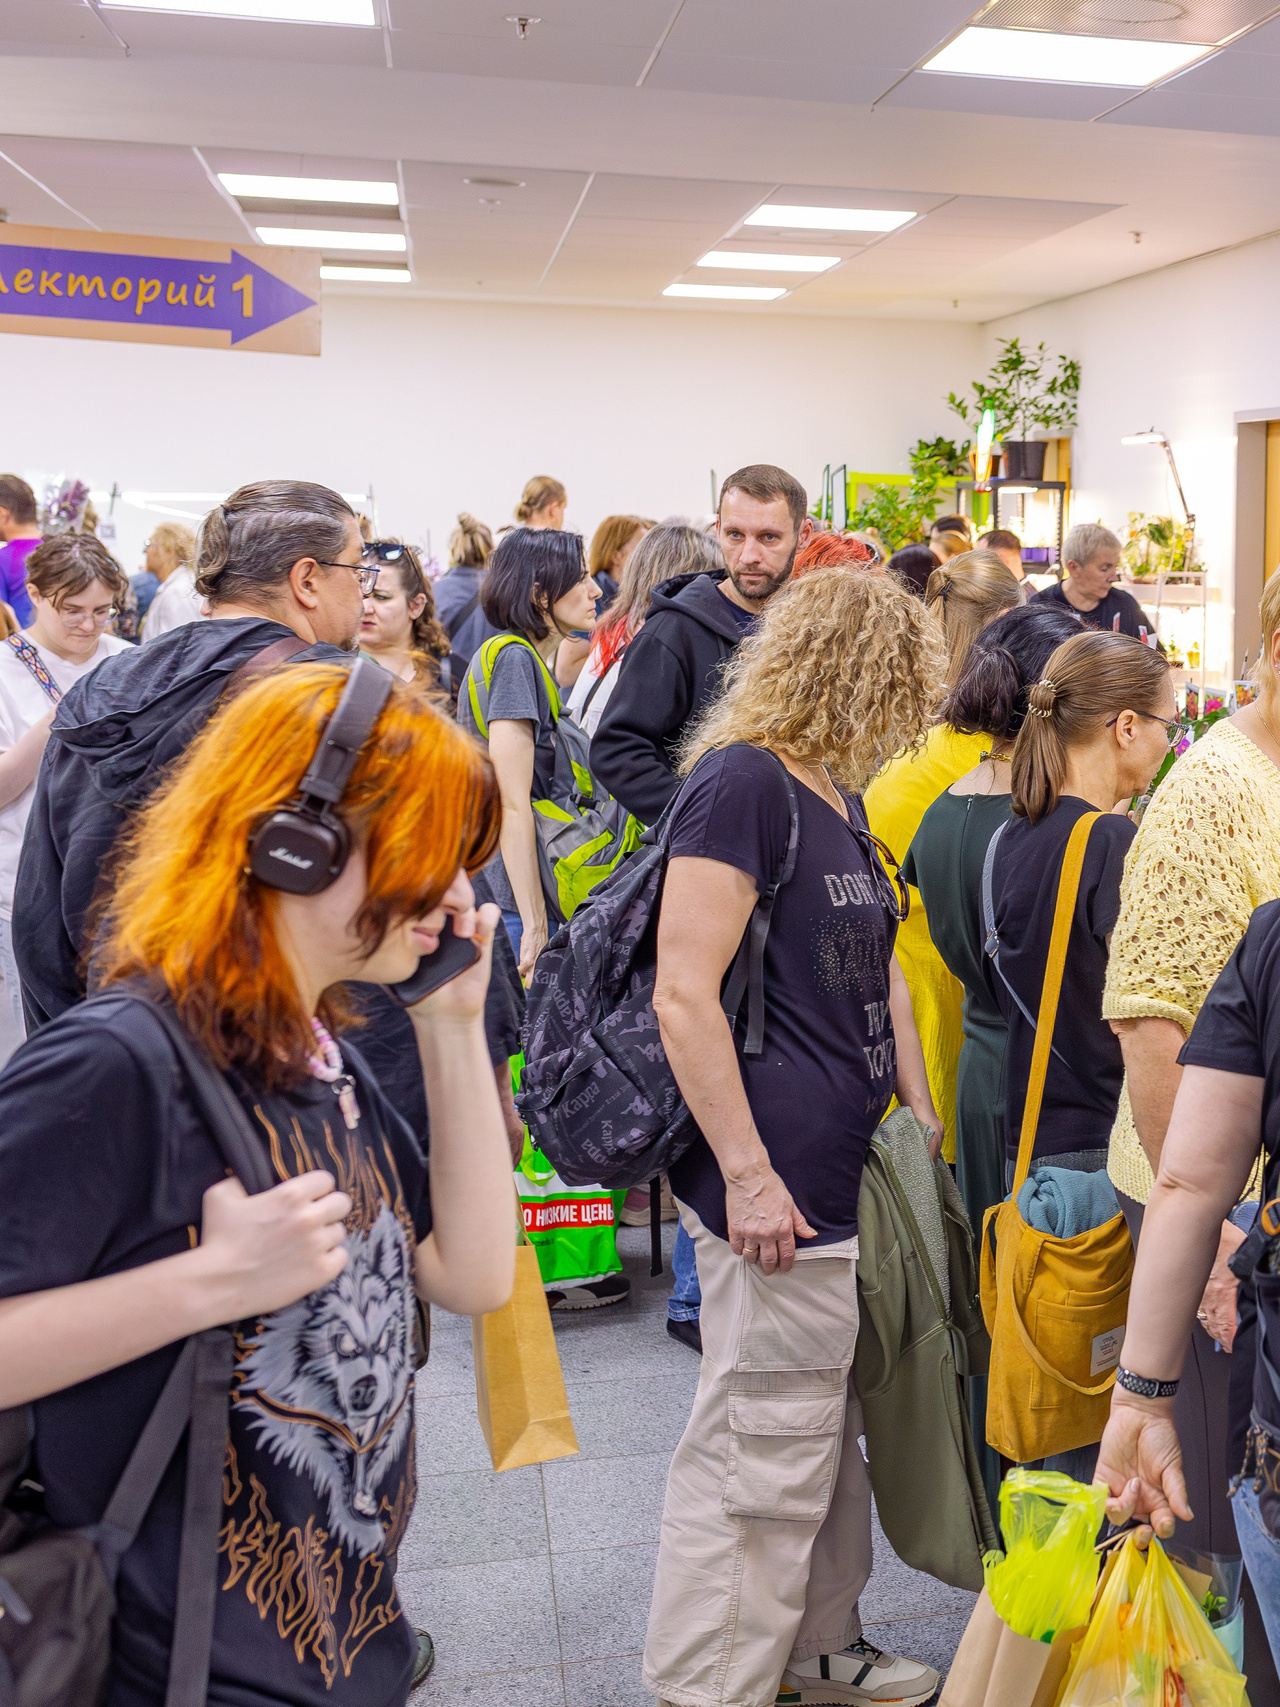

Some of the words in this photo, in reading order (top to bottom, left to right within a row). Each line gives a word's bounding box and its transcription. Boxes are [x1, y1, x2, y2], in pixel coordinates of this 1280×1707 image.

[232, 274, 253, 318] 1
[560, 1081, 600, 1119] Kappa
[535, 1205, 579, 1227] НИЗКИЕ
